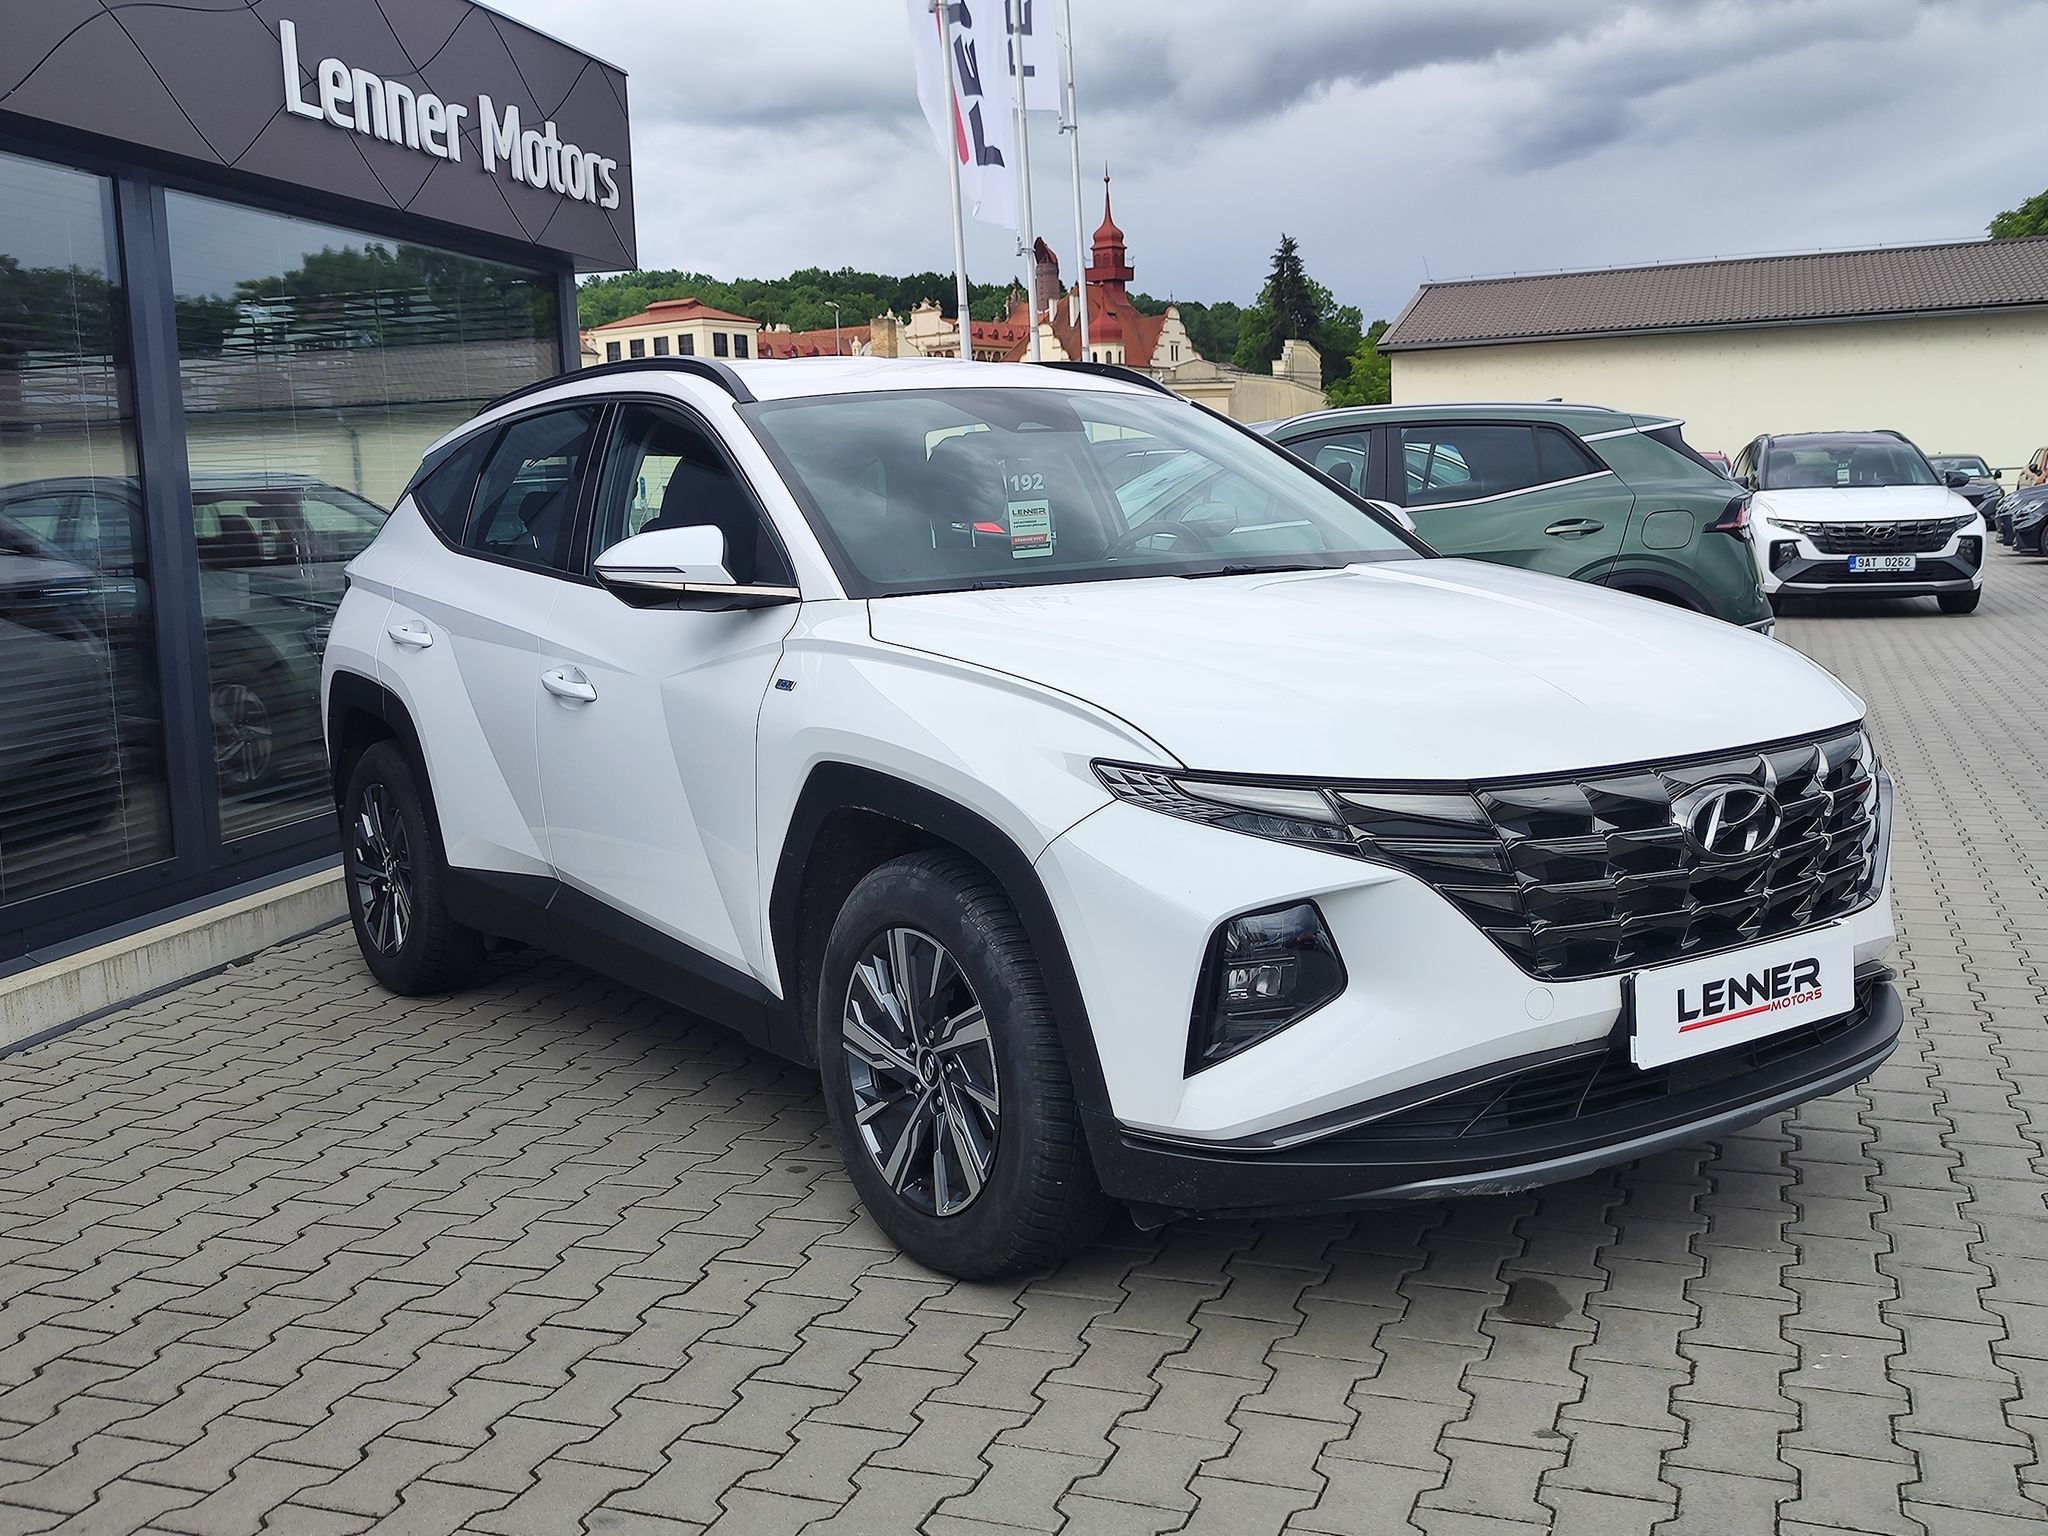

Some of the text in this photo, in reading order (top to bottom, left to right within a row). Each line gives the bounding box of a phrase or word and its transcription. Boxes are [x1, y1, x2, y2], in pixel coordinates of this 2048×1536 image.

[279, 19, 621, 210] Lenner Motors
[1010, 473, 1045, 491] 192
[1012, 507, 1046, 517] LENNER
[1858, 557, 1877, 567] 9AT
[1885, 557, 1911, 567] 0262
[1677, 957, 1821, 1023] LENNER
[1770, 988, 1822, 1011] MOTORS
